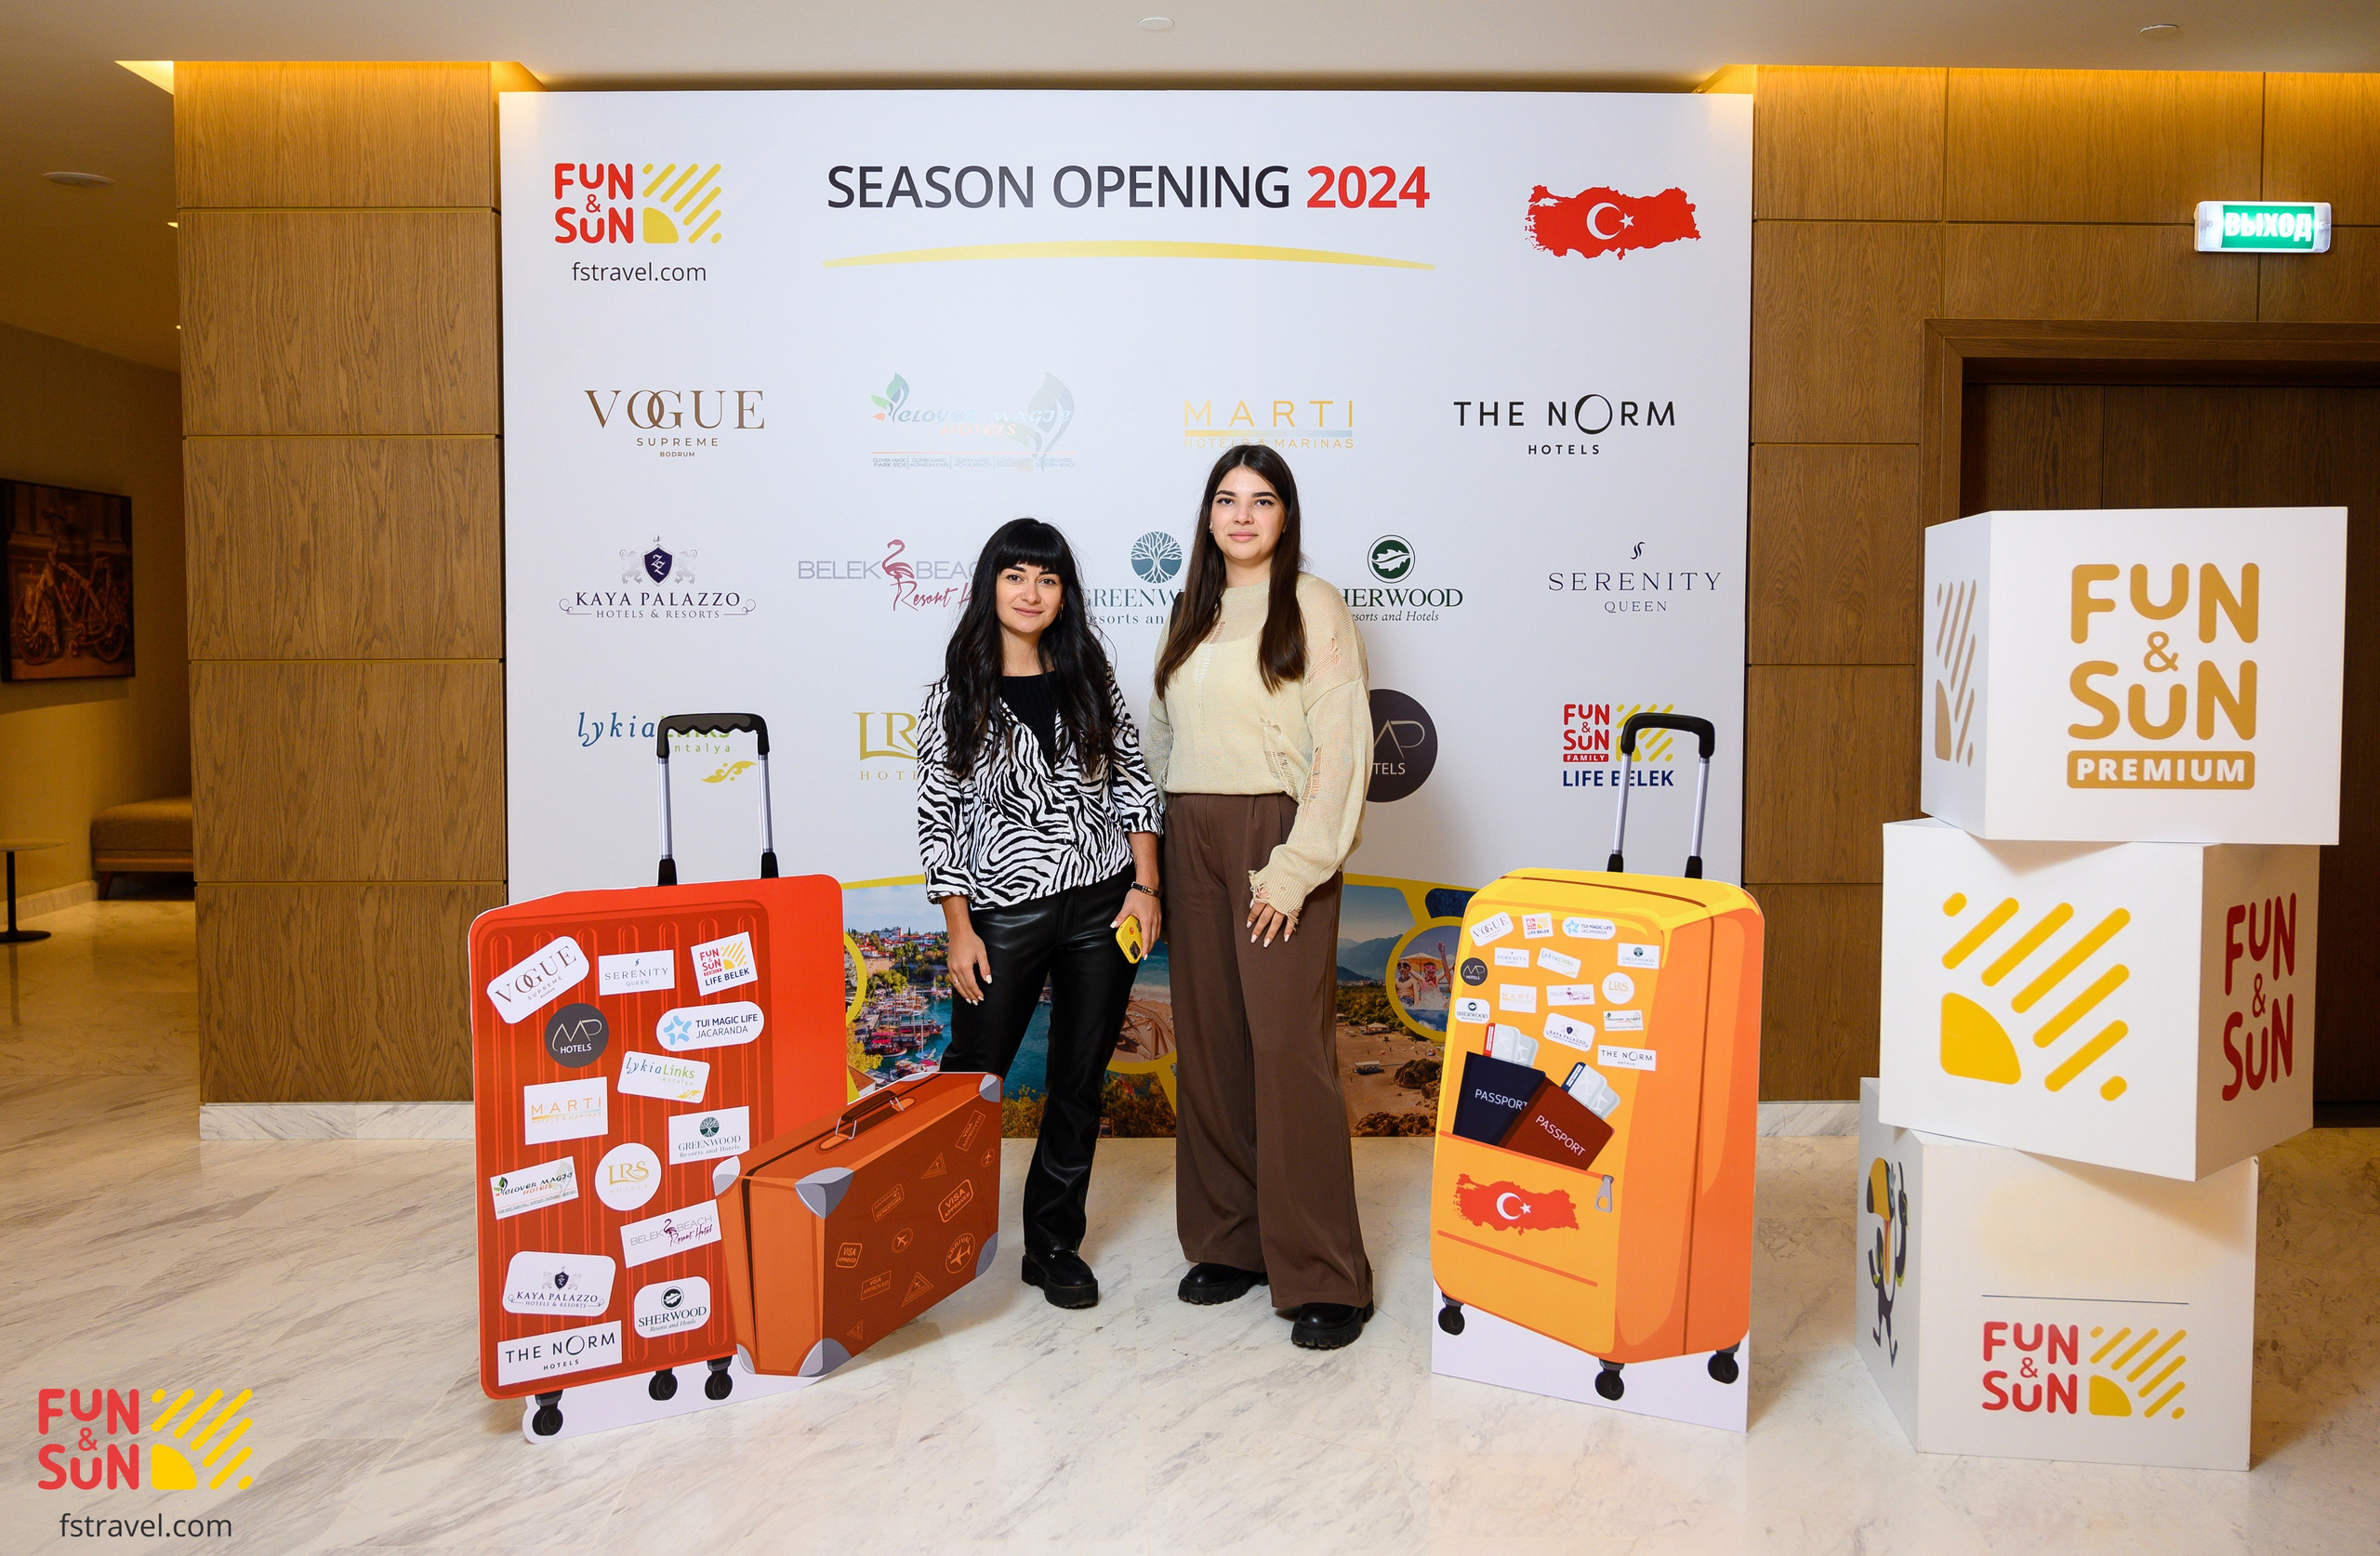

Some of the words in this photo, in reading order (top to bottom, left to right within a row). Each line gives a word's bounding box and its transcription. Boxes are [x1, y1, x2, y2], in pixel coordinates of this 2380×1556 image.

[555, 163, 634, 201] FUN
[827, 165, 1035, 208] SEASON
[1052, 165, 1290, 209] OPENING
[1306, 165, 1430, 209] 2024
[586, 193, 602, 213] &
[555, 207, 634, 244] SUN
[2225, 212, 2312, 243] ВЫХОД
[571, 261, 707, 283] fstravel.com
[584, 389, 765, 430] VOGUE
[898, 409, 977, 423] CLOVER
[987, 409, 1071, 425] MAGIC
[1183, 400, 1354, 428] MARTI
[1453, 400, 1525, 428] THE
[1549, 393, 1675, 435] NORM
[636, 438, 719, 447] SUPREME
[1274, 438, 1355, 449] MARINAS
[1527, 444, 1600, 455] HOTELS
[798, 560, 882, 580] BELEK
[916, 560, 975, 580] BEA
[1548, 572, 1722, 592] SERENITY
[575, 591, 632, 607] KAYA
[641, 591, 741, 608] PALAZZO
[1342, 587, 1463, 608] HERWOOD
[1604, 600, 1667, 613] QUEEN
[2071, 562, 2259, 644] FUN
[596, 610, 646, 619] HOTELS
[650, 610, 660, 619] &
[665, 610, 721, 619] RESORTS
[1145, 614, 1165, 625] an
[1382, 611, 1402, 622] and
[1406, 611, 1439, 622] Hotels
[2143, 631, 2179, 672] &
[2068, 660, 2256, 741] SUN
[1564, 704, 1609, 726] FUN
[1581, 721, 1591, 732] &
[674, 744, 731, 755] ntalya
[1563, 729, 1609, 751] SUN
[860, 771, 919, 781] HOTE
[1373, 762, 1406, 775] TELS
[1563, 771, 1604, 786] LIFE
[2077, 758, 2244, 783] PREMIUM
[1473, 916, 1509, 938] VOGUE
[2225, 891, 2296, 996] FUN
[699, 947, 720, 961] FUN
[495, 945, 577, 1005] VOGUE
[604, 967, 669, 981] SERENITY
[702, 958, 722, 972] SUN
[705, 975, 722, 987] LIFE
[724, 968, 750, 982] BELEK
[527, 976, 562, 1001] SUPREME
[2251, 972, 2267, 1018] &
[695, 1019, 709, 1028] TUI
[712, 1016, 739, 1027] MAGIC
[741, 1013, 759, 1024] LIFE
[695, 1024, 748, 1039] JACARANDA
[560, 1044, 592, 1055] HOTELS
[1601, 1049, 1618, 1058] THE
[1622, 1050, 1653, 1062] NORM
[2222, 993, 2294, 1101] SUN
[531, 1096, 602, 1116] MARTI
[531, 1116, 560, 1125] HOTELS
[568, 1112, 602, 1121] MARINAS
[678, 1135, 741, 1152] GREENWOOD
[1535, 1114, 1586, 1156] PASSPORT
[680, 1150, 704, 1158] Resorts
[705, 1147, 718, 1155] and
[719, 1143, 741, 1154] Hotels
[608, 1160, 650, 1185] LRS
[945, 1188, 966, 1208] VISA
[630, 1231, 664, 1246] BELEK
[677, 1215, 713, 1233] BEACH
[516, 1291, 545, 1300] KAYA
[549, 1292, 598, 1303] PALAZZO
[638, 1306, 707, 1327] SHERWOOD
[505, 1345, 541, 1364] THE
[552, 1332, 615, 1355] NORM
[1982, 1321, 2079, 1365] FUN
[543, 1359, 580, 1371] HOTELS
[2019, 1356, 2039, 1378] &
[1981, 1369, 2079, 1415] SUN
